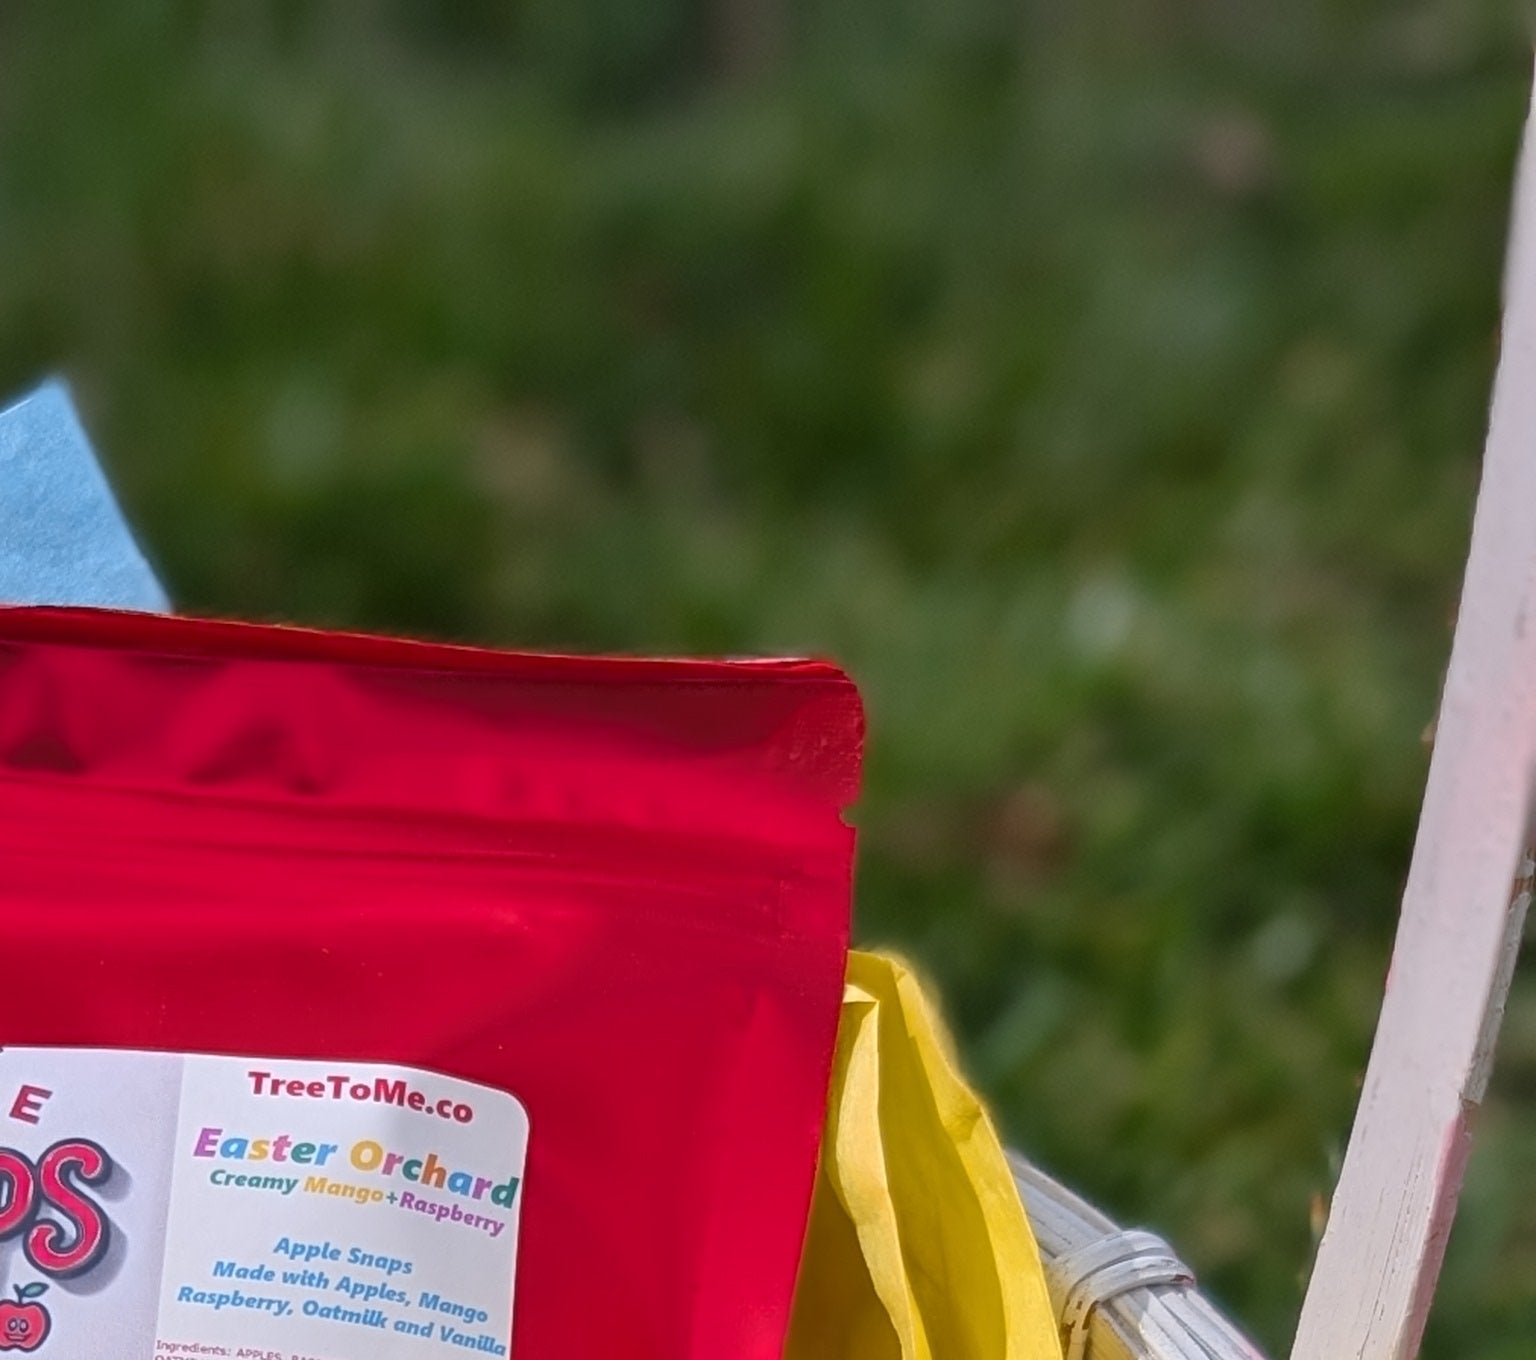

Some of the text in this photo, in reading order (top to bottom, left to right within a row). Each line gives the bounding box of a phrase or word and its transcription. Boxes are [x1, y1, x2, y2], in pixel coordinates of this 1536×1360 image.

[248, 1071, 474, 1124] TreeToMe.co
[192, 1127, 520, 1210] Easter Orchard
[210, 1168, 298, 1195] Creamy
[273, 1237, 413, 1276] Apple Snaps
[212, 1260, 489, 1325] Made with Apples, Mango
[156, 1340, 231, 1356] Ingredients:
[178, 1286, 507, 1357] Raspberry, Oatmilk and Vanilla
